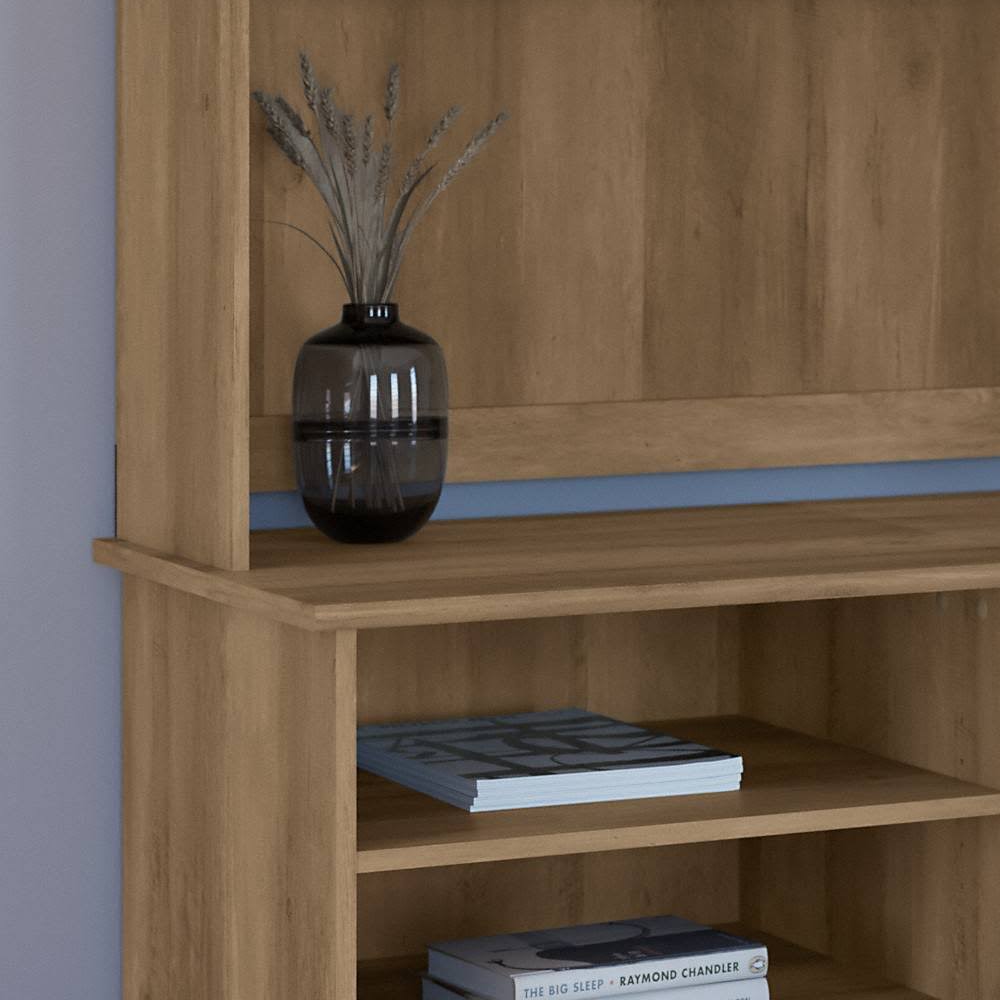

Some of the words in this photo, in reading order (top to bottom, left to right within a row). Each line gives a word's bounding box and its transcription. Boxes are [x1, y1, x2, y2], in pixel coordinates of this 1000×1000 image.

[524, 986, 544, 999] THE
[548, 984, 569, 996] BIG
[573, 978, 604, 993] SLEEP
[619, 970, 677, 987] RAYMOND
[682, 961, 740, 979] CHANDLER
